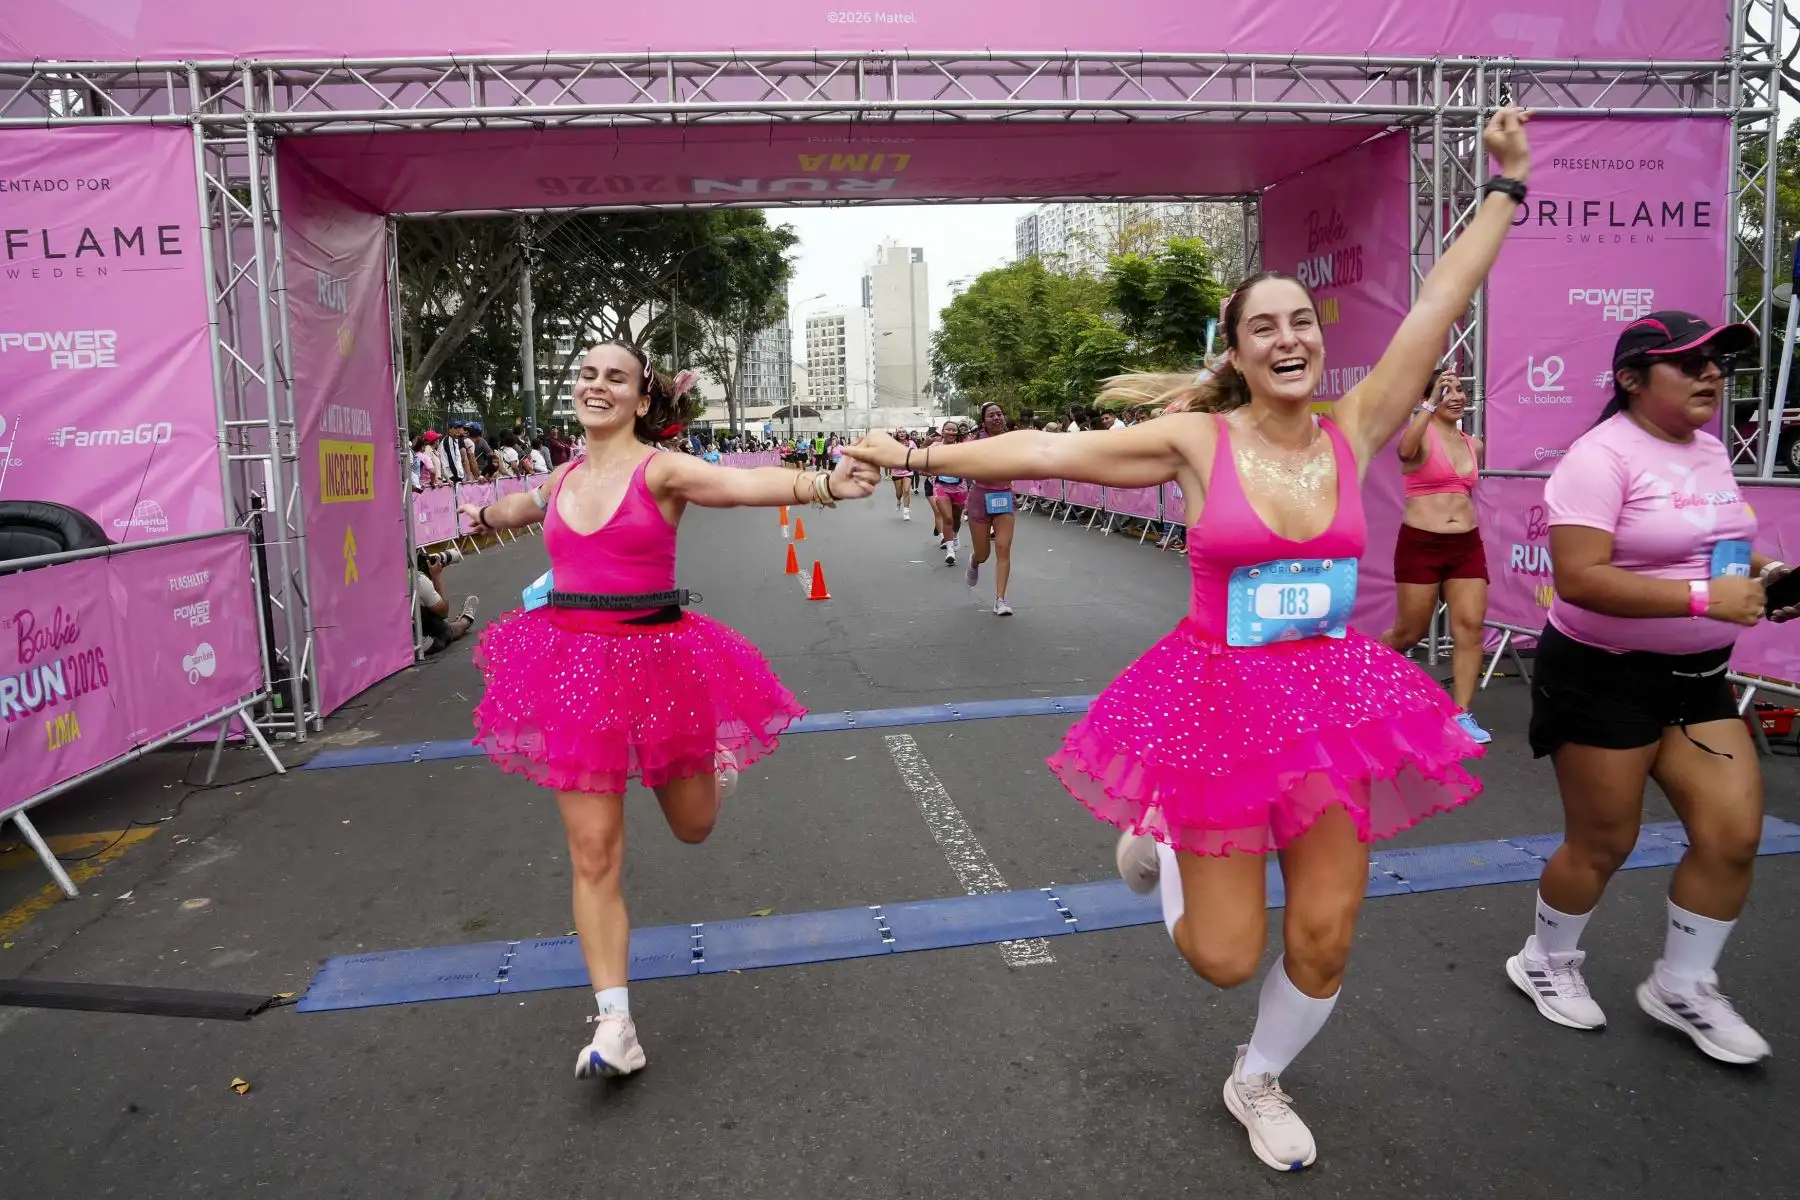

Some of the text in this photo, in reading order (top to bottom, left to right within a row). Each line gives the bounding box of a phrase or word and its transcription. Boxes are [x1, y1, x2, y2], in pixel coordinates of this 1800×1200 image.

[798, 153, 911, 171] LIMA
[1552, 158, 1665, 171] PRESENTADO POR
[77, 178, 111, 191] POR
[692, 177, 896, 196] RUN
[1566, 233, 1655, 244] SWEDEN
[1297, 254, 1333, 289] RUN
[1568, 288, 1655, 305] POWER
[1603, 305, 1652, 322] ADE
[0, 329, 118, 352] POWER
[51, 349, 119, 371] ADE
[174, 600, 209, 621] POWER
[1277, 586, 1310, 616] 183
[13, 606, 80, 664] Barbie
[0, 646, 109, 722] RUN 2026
[45, 711, 82, 751] LIMA
